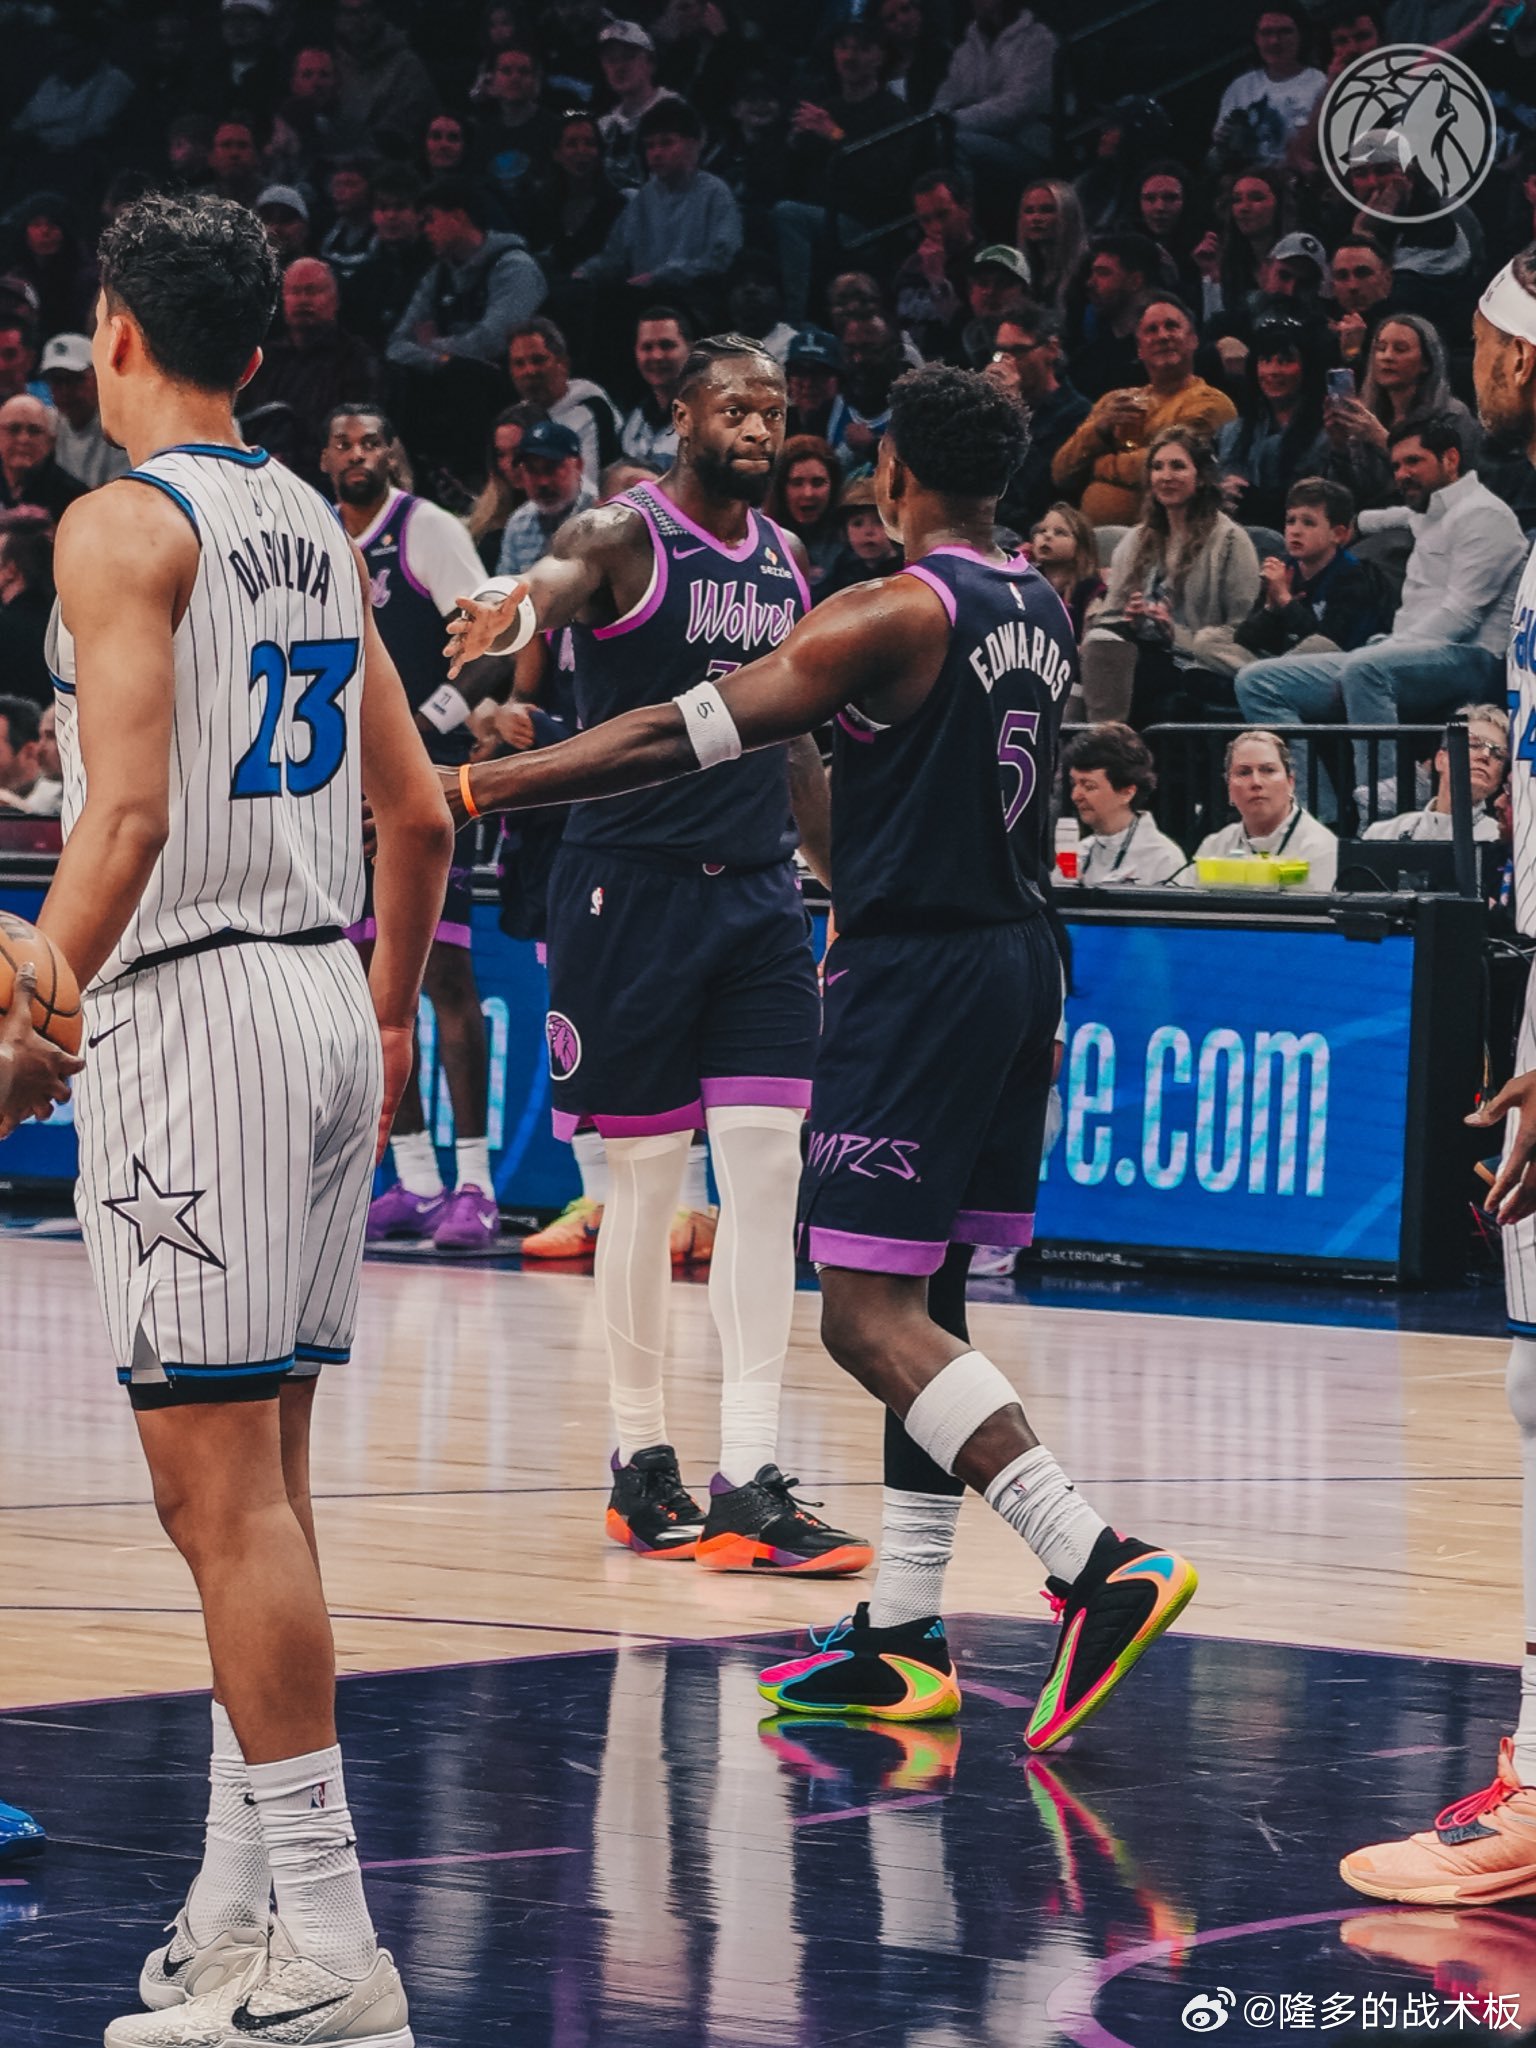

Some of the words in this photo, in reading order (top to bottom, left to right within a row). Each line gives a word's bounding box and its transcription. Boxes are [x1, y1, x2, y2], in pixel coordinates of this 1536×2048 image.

[760, 564, 792, 579] sezzle
[686, 579, 796, 651] Wolves
[969, 621, 1071, 702] EDWARDS
[229, 638, 360, 801] 23
[696, 701, 715, 719] 5
[997, 710, 1041, 833] 5
